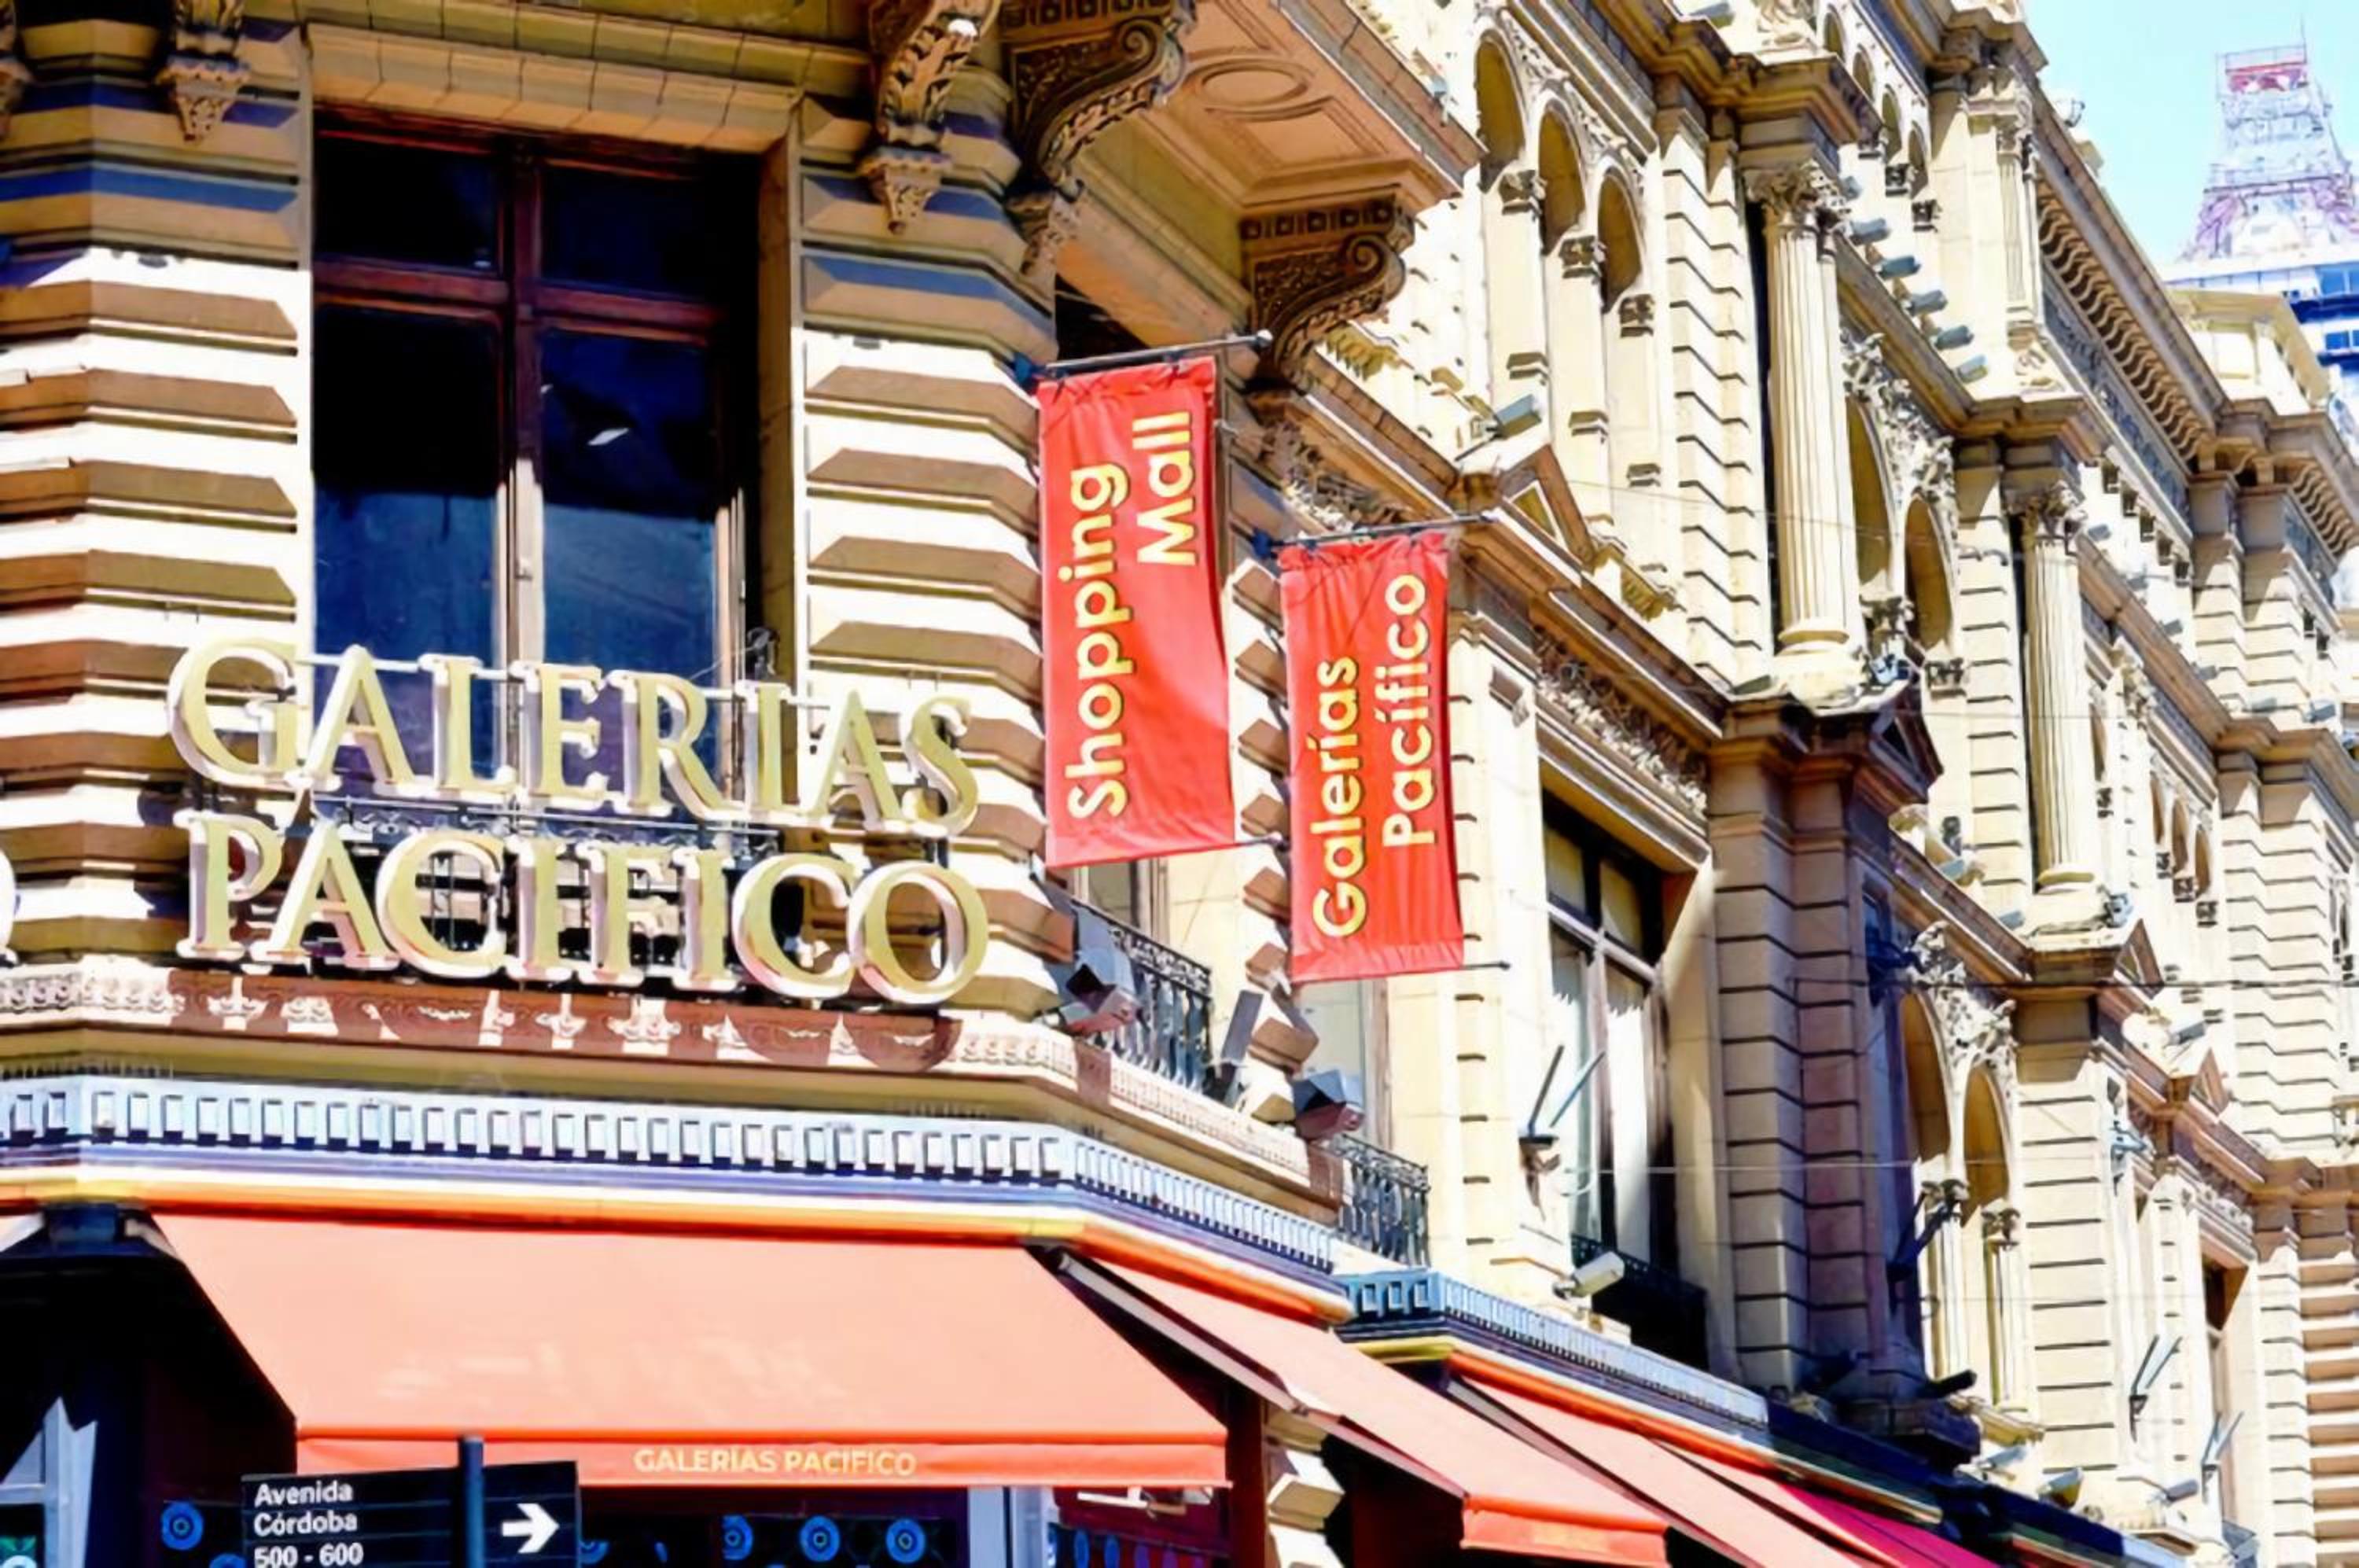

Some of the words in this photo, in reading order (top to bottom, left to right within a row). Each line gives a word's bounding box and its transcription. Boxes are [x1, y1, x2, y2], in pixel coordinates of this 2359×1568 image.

[1132, 410, 1198, 566] Mall
[166, 639, 978, 837] GALERIAS
[1058, 462, 1135, 819] Shopping
[1375, 573, 1436, 848] Pacífico
[1312, 655, 1368, 937] Galerías
[174, 808, 988, 1005] PACIFICO
[253, 1510, 358, 1537] Córdoba
[254, 1546, 298, 1568] 500
[319, 1542, 364, 1566] 600
[255, 1480, 353, 1507] Avenida
